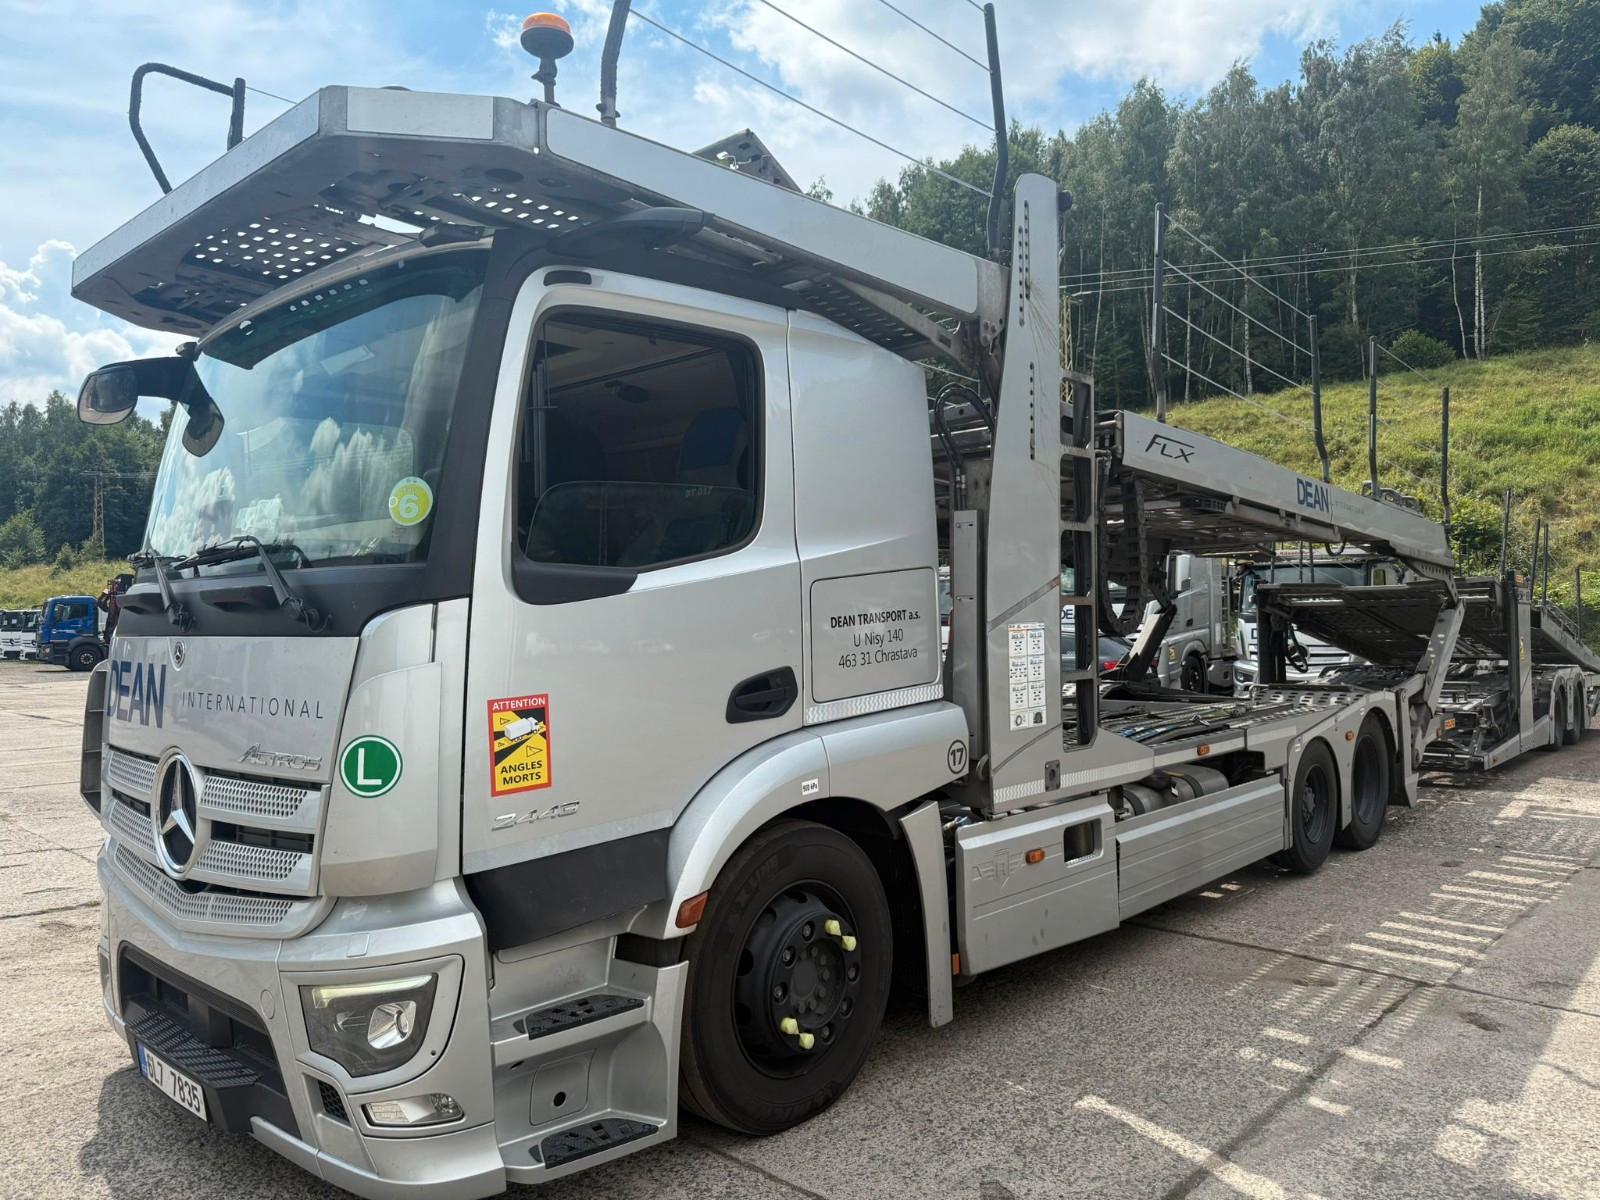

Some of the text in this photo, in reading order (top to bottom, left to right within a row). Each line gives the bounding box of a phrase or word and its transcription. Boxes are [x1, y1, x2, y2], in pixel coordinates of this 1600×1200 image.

[1145, 434, 1195, 463] FLX
[1296, 478, 1330, 513] DEAN
[399, 495, 418, 518] 6
[830, 609, 921, 628] DEAN TRANSPORT a.s.
[853, 628, 904, 648] U Nisy 140
[838, 648, 918, 668] 463 31 Chrastava
[106, 660, 324, 729] DEAN INTERNATIONAL
[492, 697, 546, 711] ATTENTION
[356, 747, 383, 786] L
[950, 747, 964, 767] 17
[500, 760, 543, 775] ANGLES
[502, 771, 542, 786] MORTS
[146, 1053, 201, 1113] 6L7 7835
